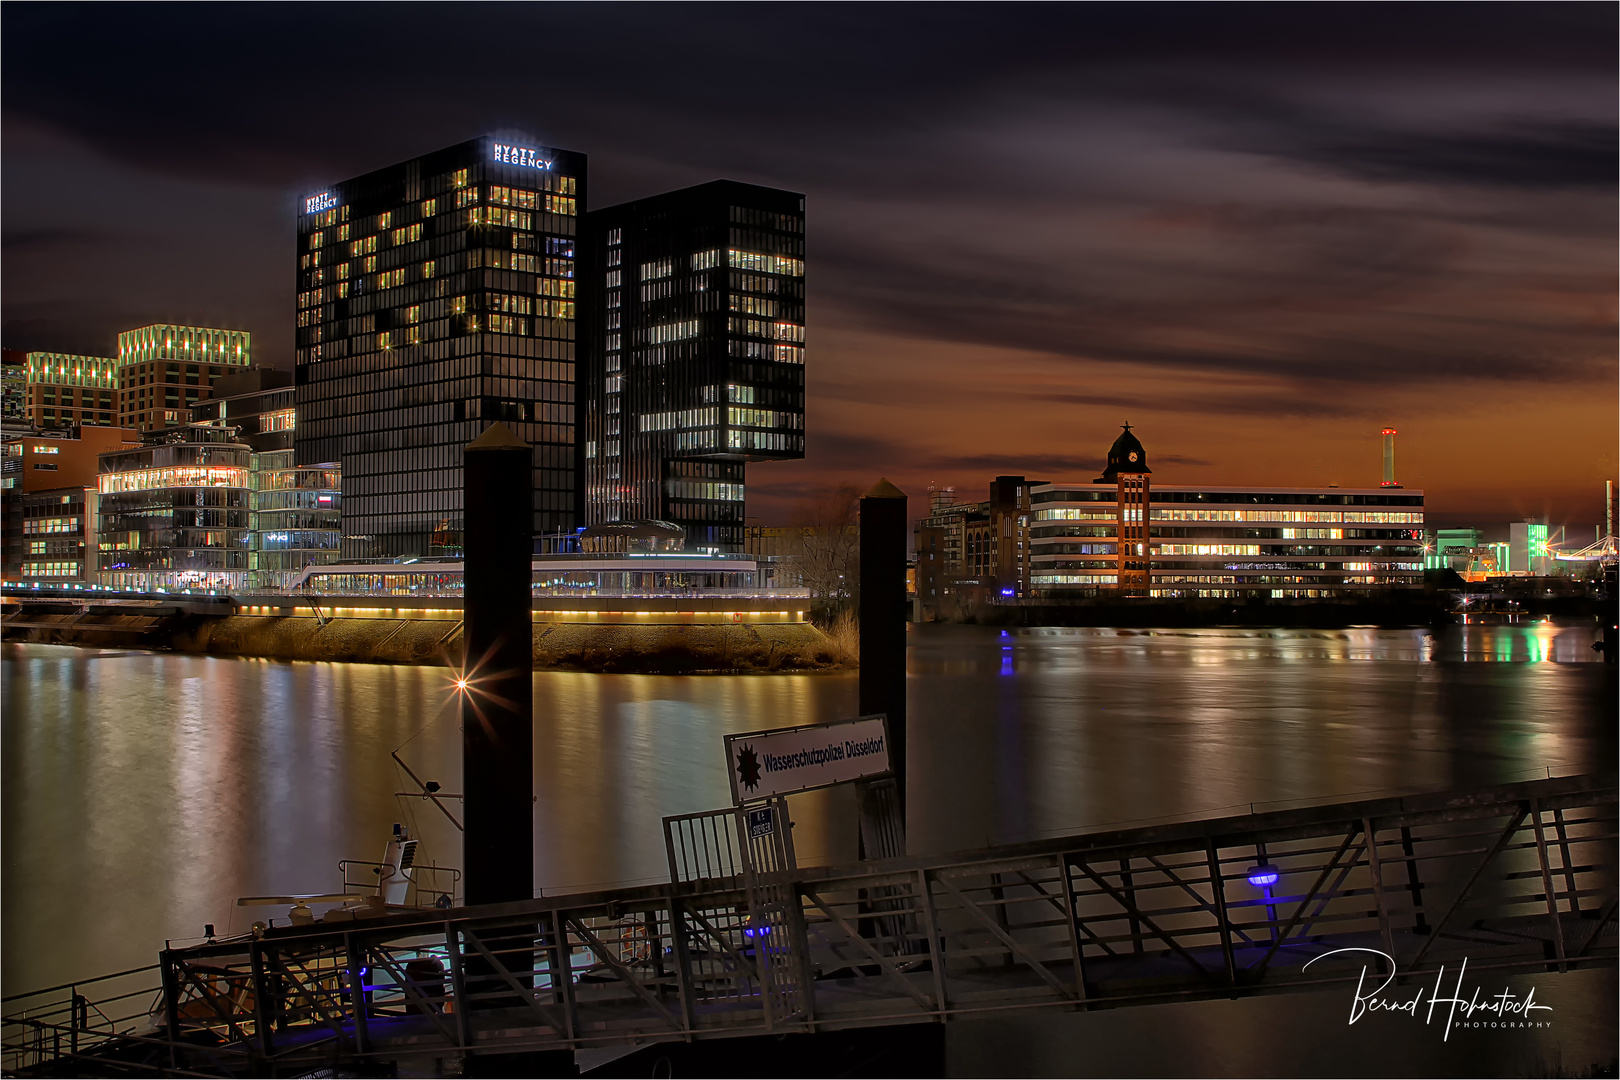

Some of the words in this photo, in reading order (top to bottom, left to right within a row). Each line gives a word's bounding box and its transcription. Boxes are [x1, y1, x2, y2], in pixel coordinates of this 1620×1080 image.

[494, 143, 536, 159] HYATT
[494, 152, 552, 170] REGENCY
[305, 192, 328, 206] HYATT
[306, 197, 337, 214] REGENCY
[762, 742, 845, 773] Wasserschutzpolizei
[845, 736, 884, 758] Düsseldorf
